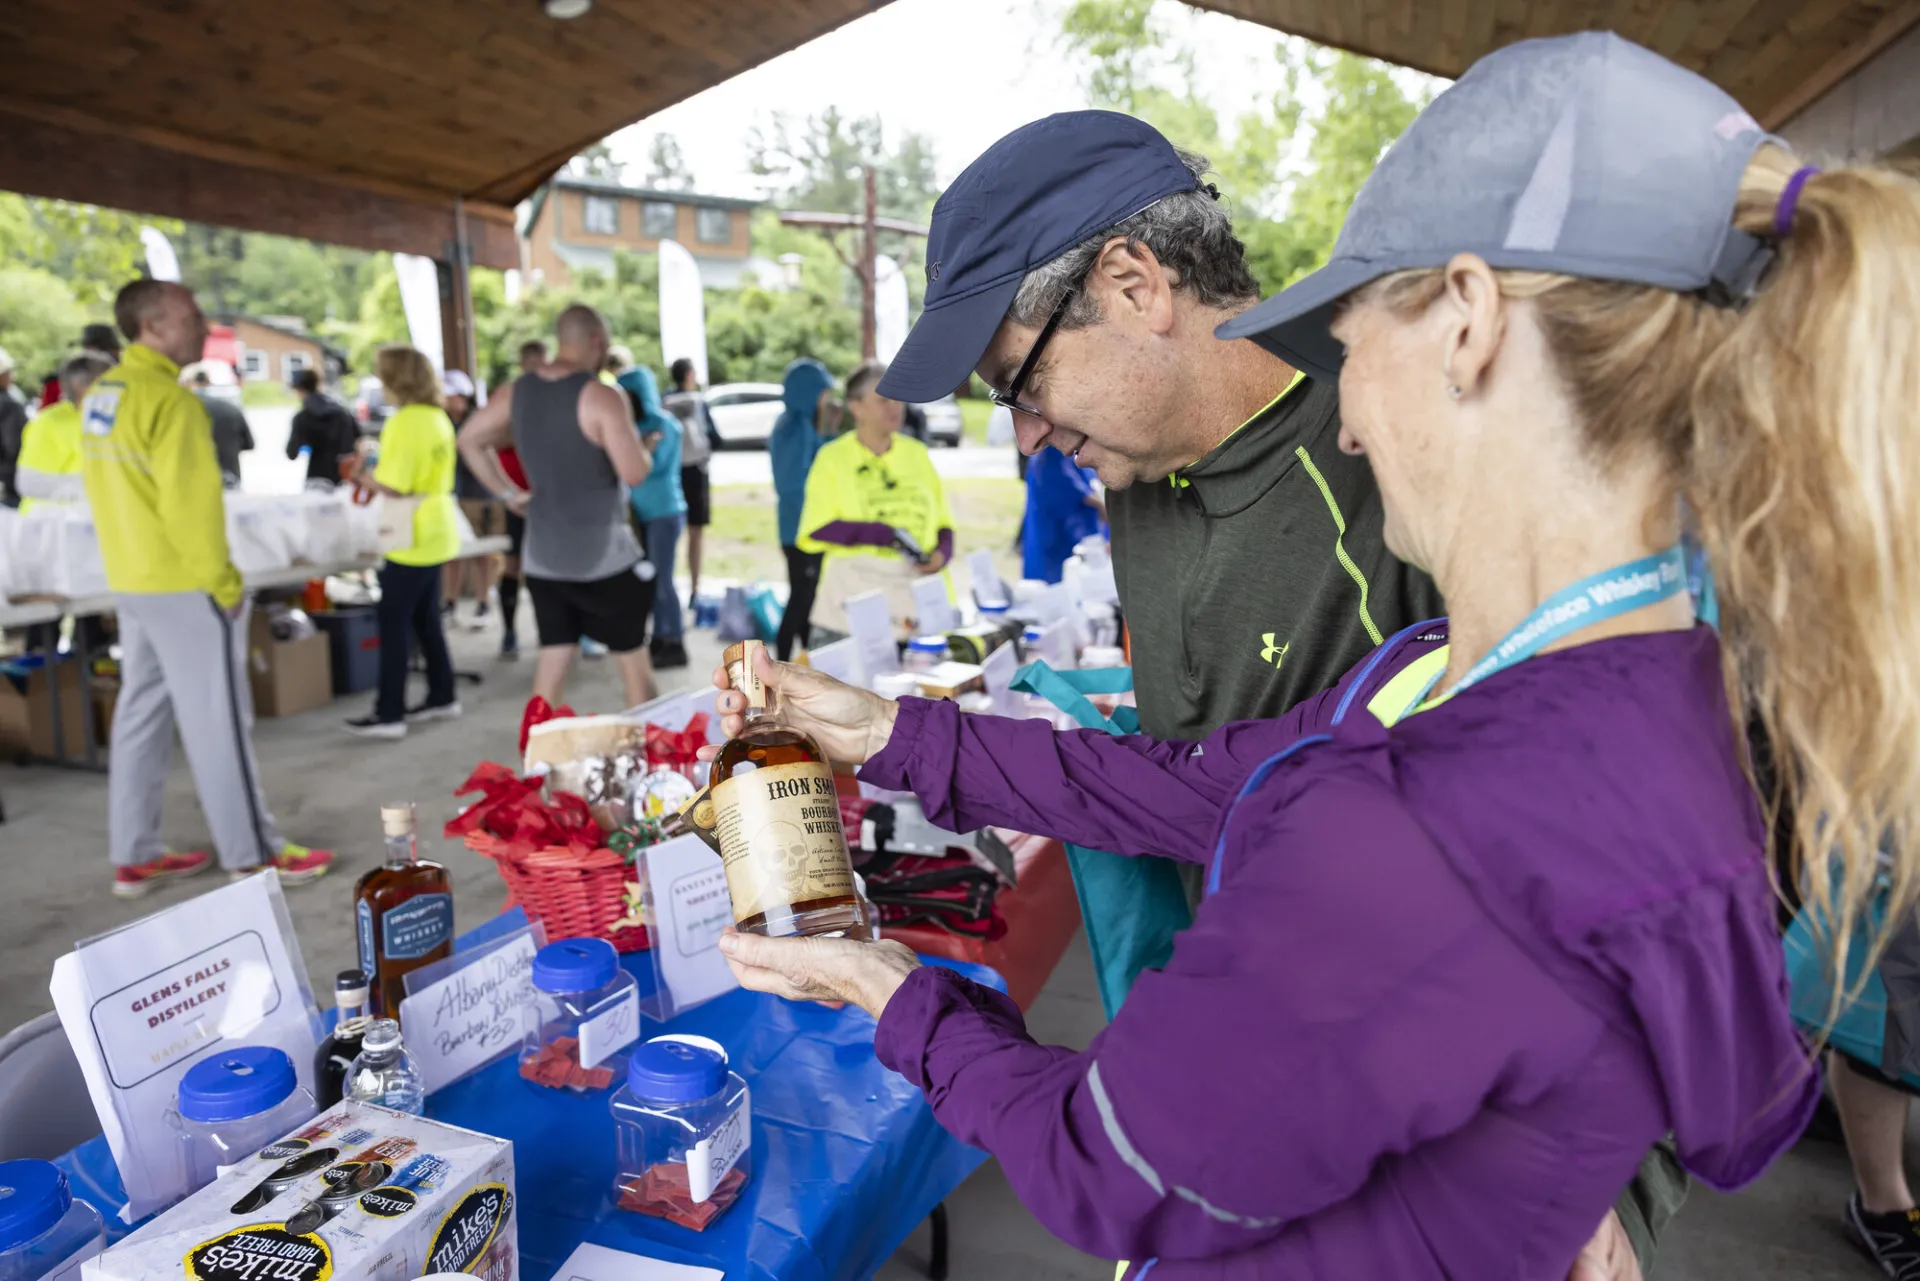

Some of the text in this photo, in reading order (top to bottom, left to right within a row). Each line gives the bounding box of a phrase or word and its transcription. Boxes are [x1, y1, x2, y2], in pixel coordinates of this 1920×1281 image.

[767, 778, 810, 800] IRON
[393, 922, 443, 945] WHISKEY
[131, 958, 231, 1013] GLENS FALLS
[434, 973, 497, 1027] Albany
[147, 981, 227, 1028] DISTILERY
[151, 1037, 189, 1063] MAPLE
[409, 1166, 442, 1182] BLUE
[362, 1193, 415, 1212] mike's
[228, 1234, 320, 1262] HARD FREEZE
[432, 1193, 499, 1273] mike's
[464, 1215, 495, 1256] FREEZE
[200, 1246, 317, 1281] mike's
